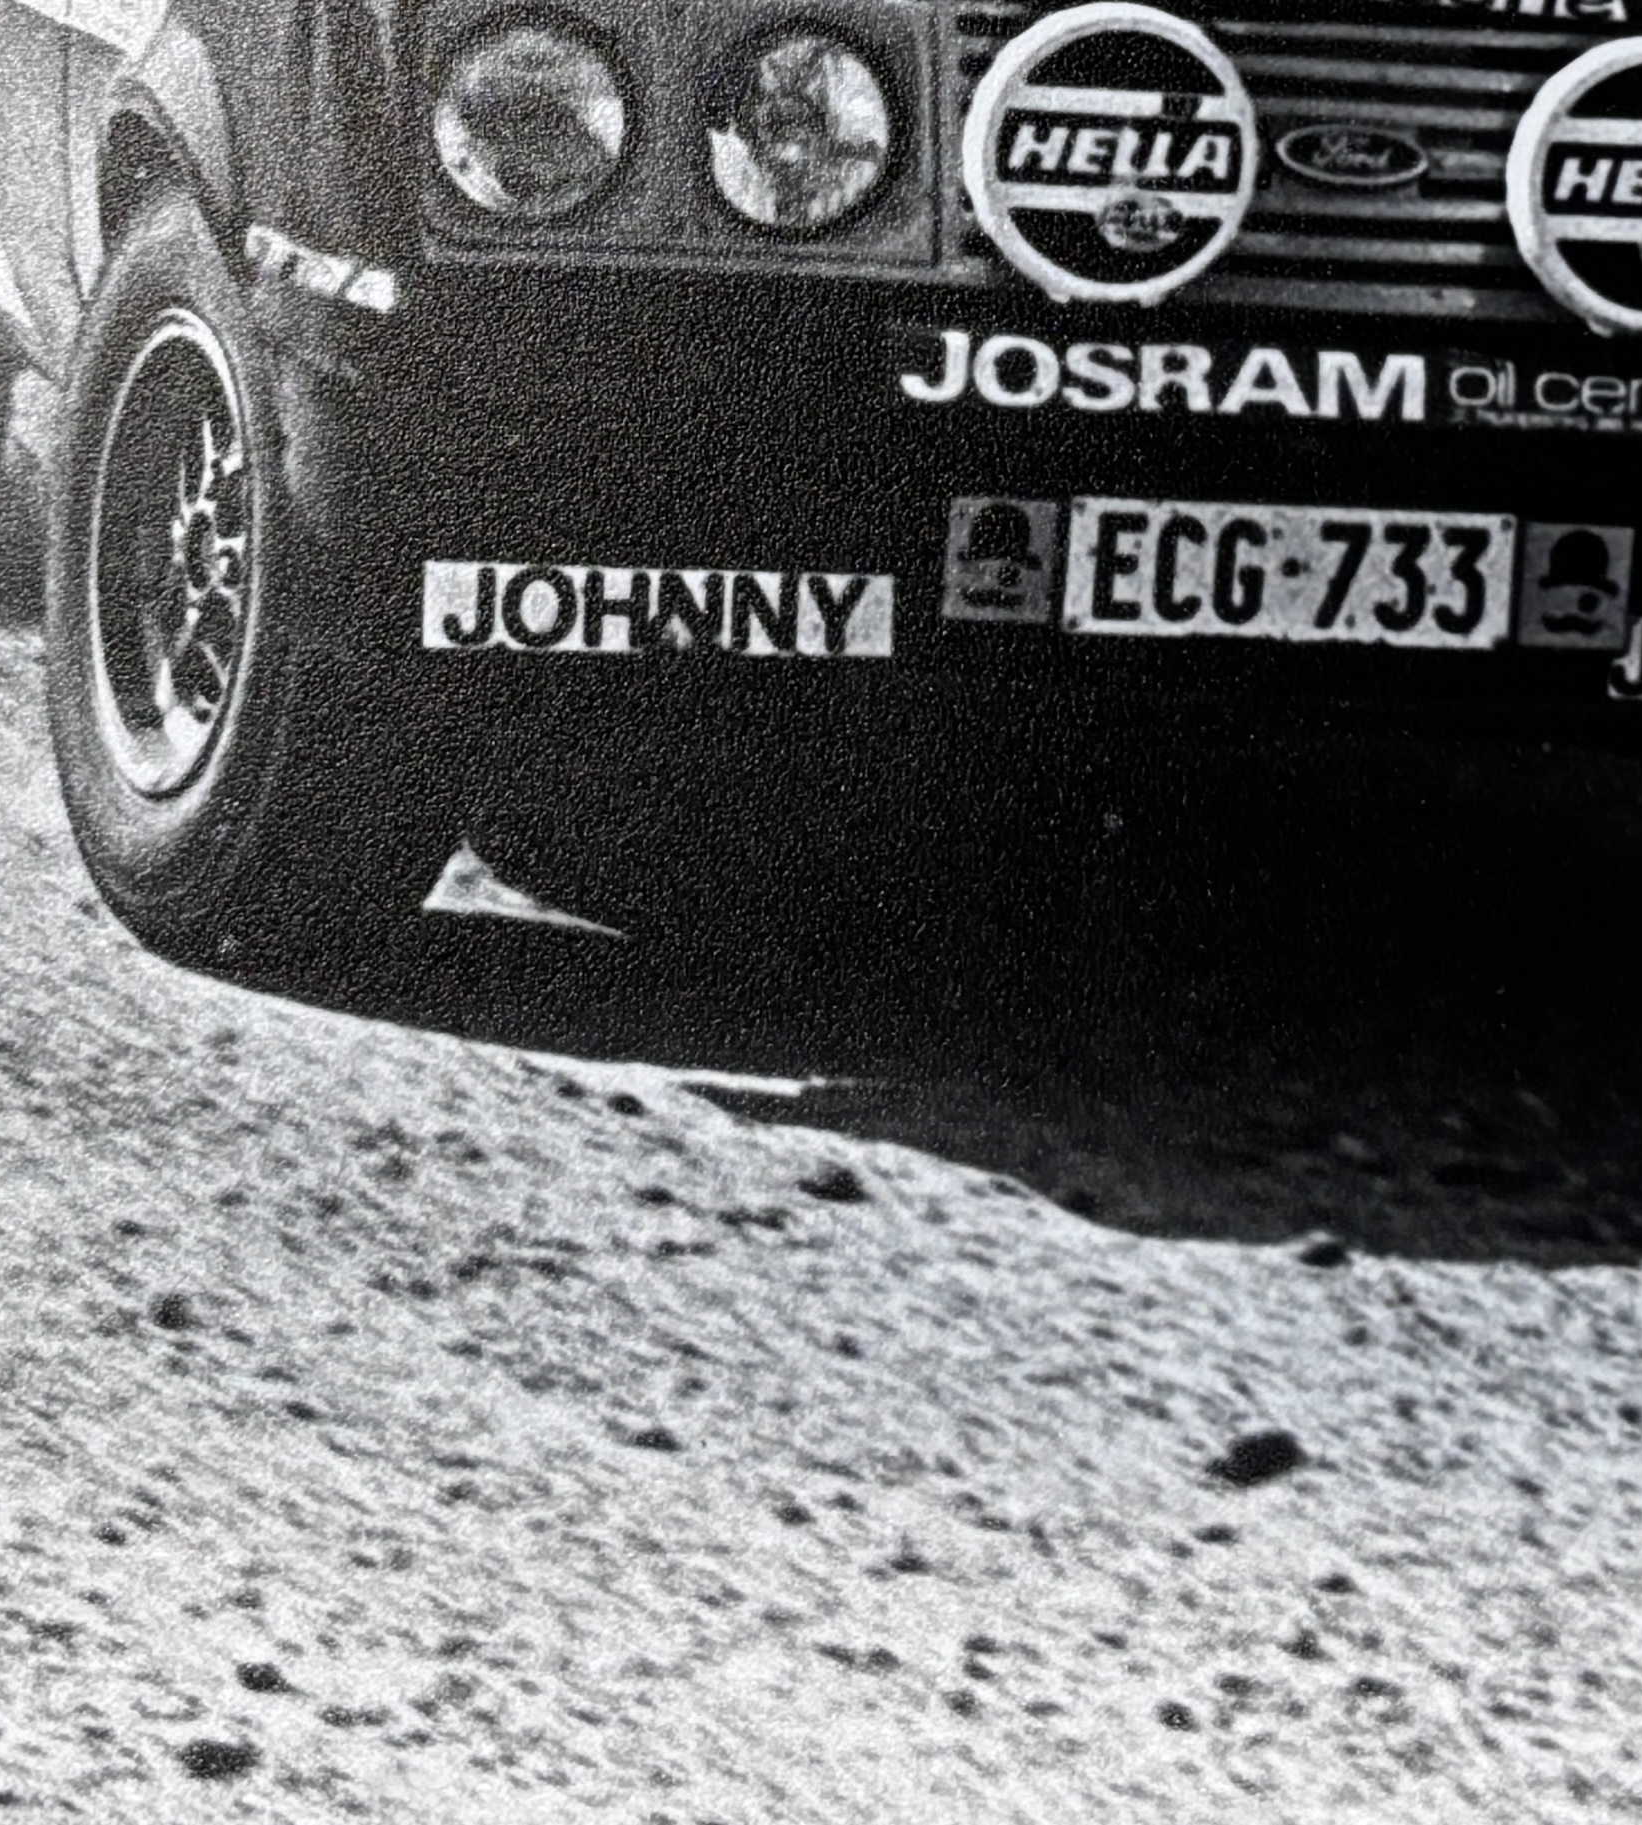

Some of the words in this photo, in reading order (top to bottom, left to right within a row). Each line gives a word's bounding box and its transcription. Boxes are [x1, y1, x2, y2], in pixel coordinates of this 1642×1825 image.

[1008, 124, 1232, 179] HELLA
[899, 331, 1426, 421] JOSRAM
[442, 567, 870, 654] JOHNNY
